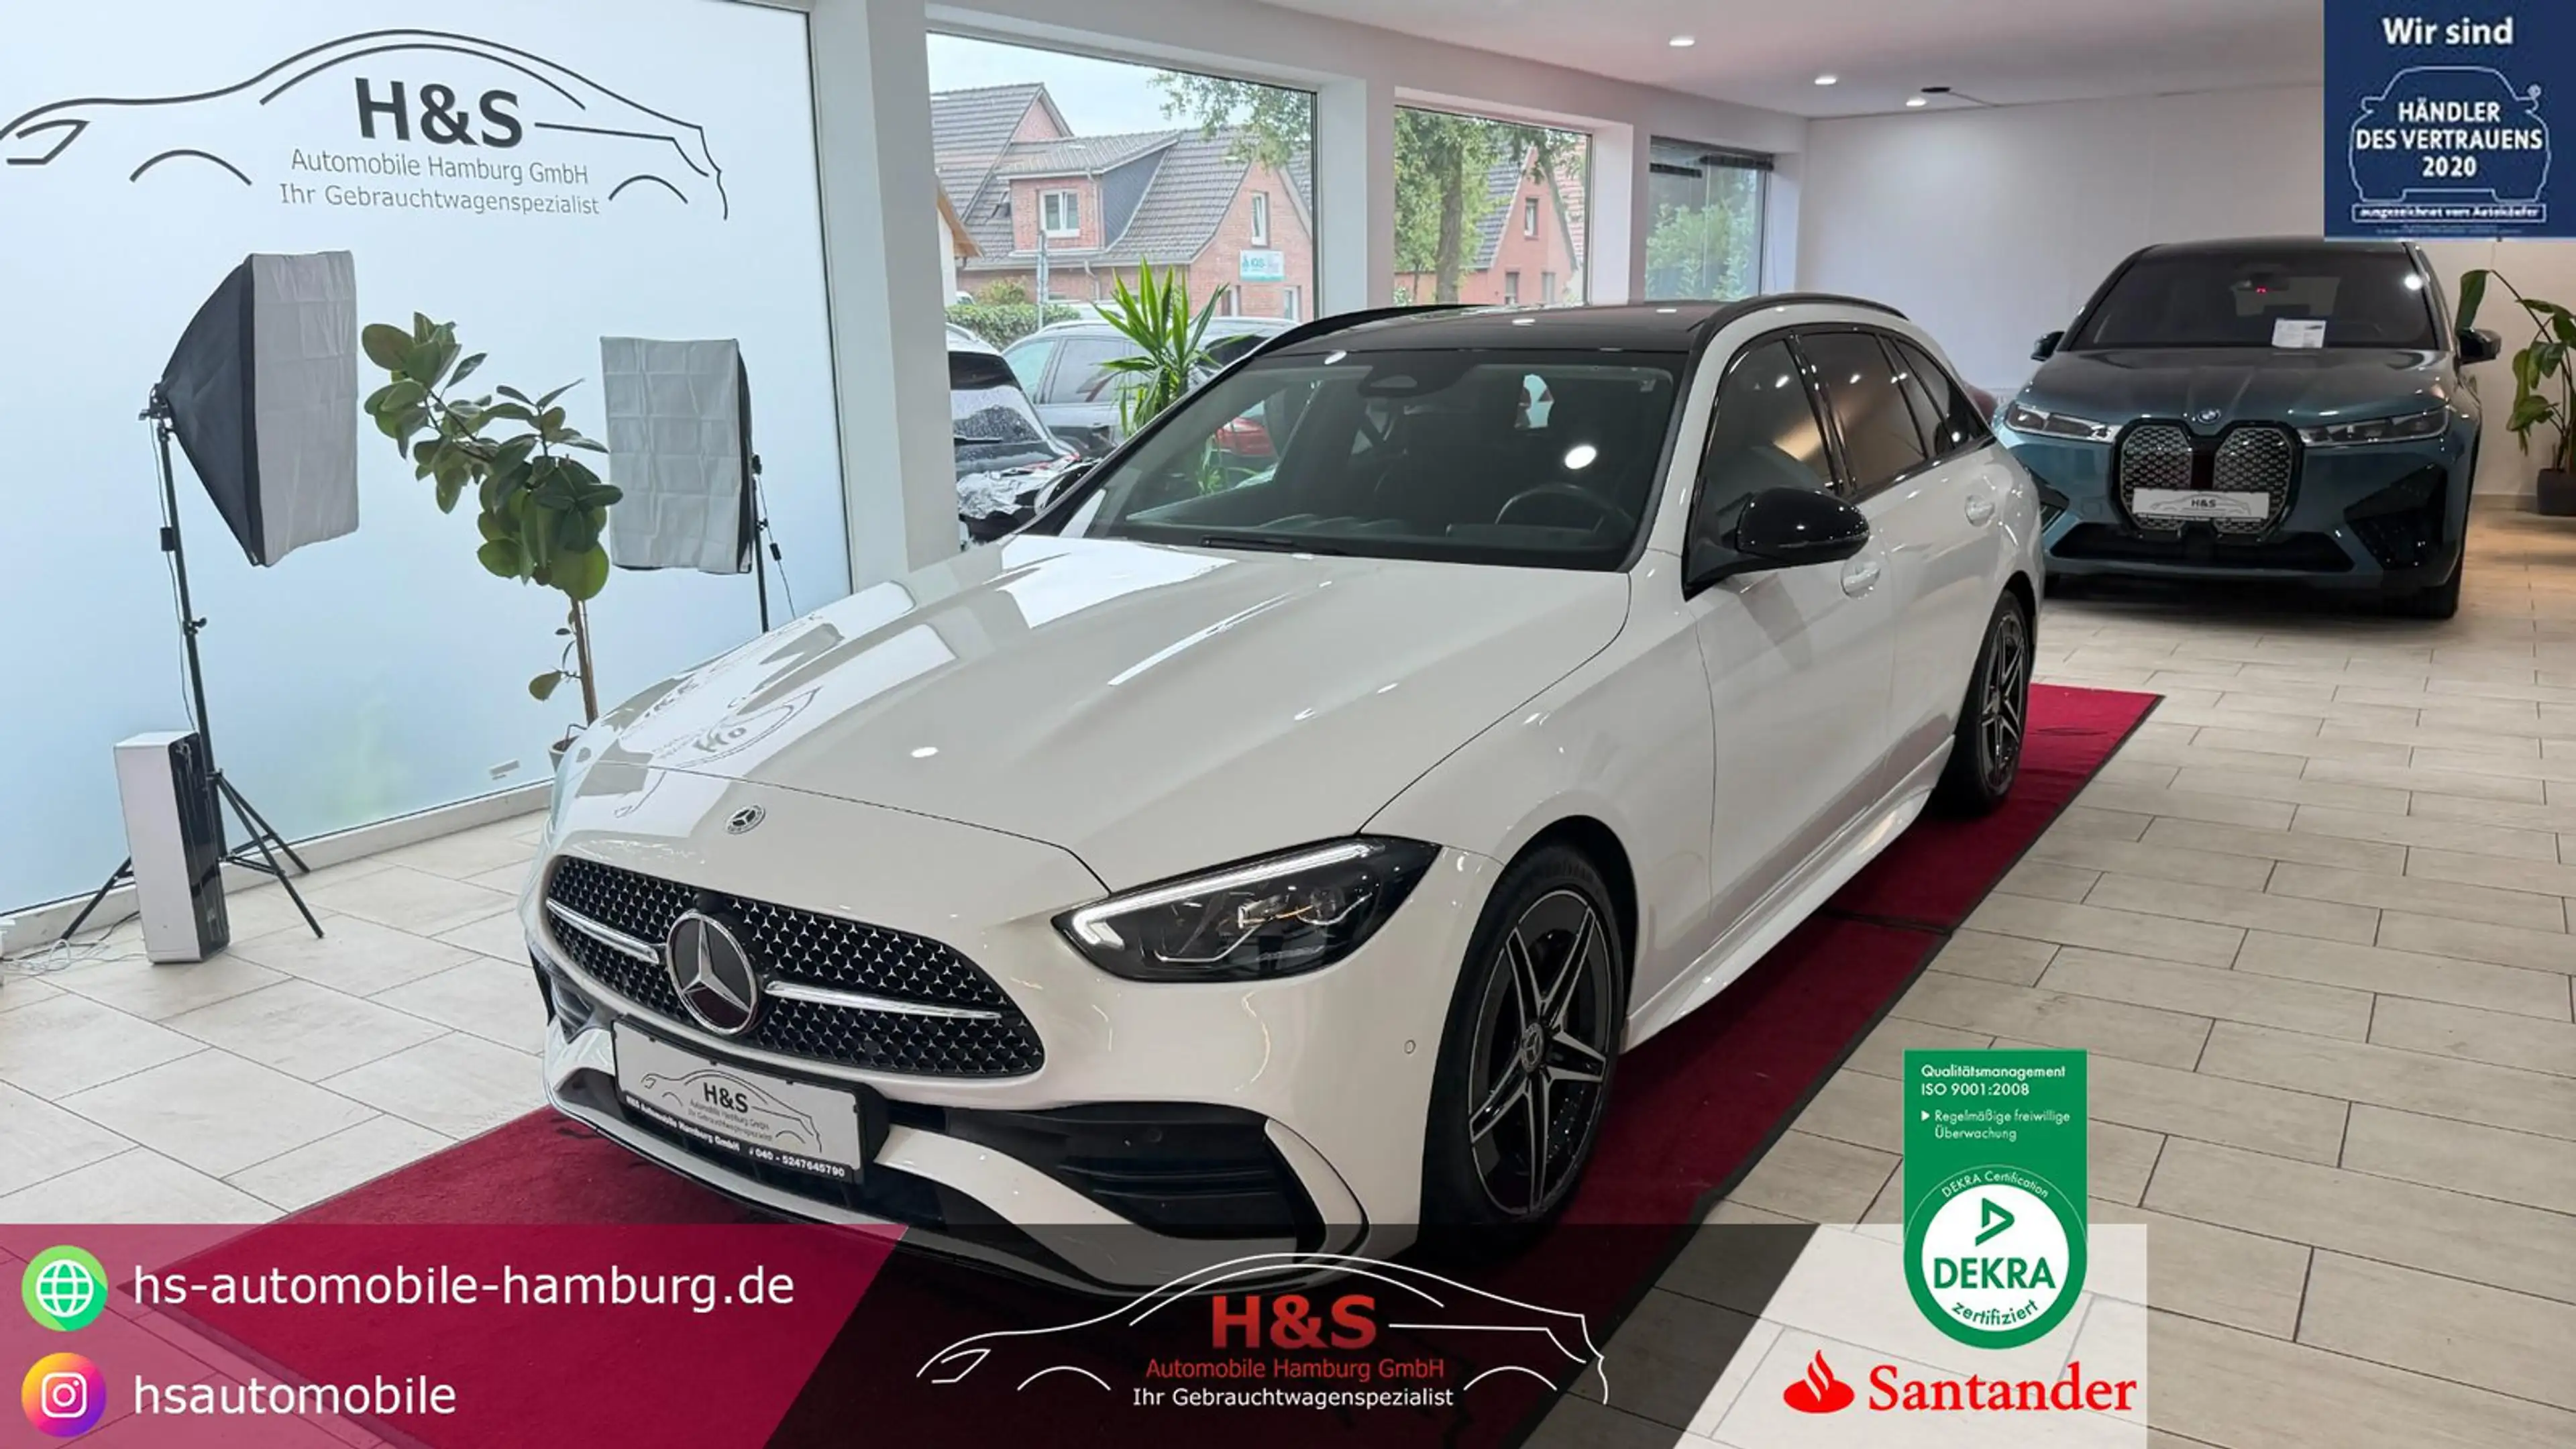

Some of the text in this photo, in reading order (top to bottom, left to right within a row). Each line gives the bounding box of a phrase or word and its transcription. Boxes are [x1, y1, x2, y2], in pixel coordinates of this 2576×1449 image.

[355, 77, 523, 148] H&S
[291, 148, 589, 186] Automobile Hamburg GmbH
[280, 183, 600, 215] Ihr Gebrauchtwagenspezialist
[2191, 499, 2216, 508] H&S
[703, 1081, 749, 1114] H&S
